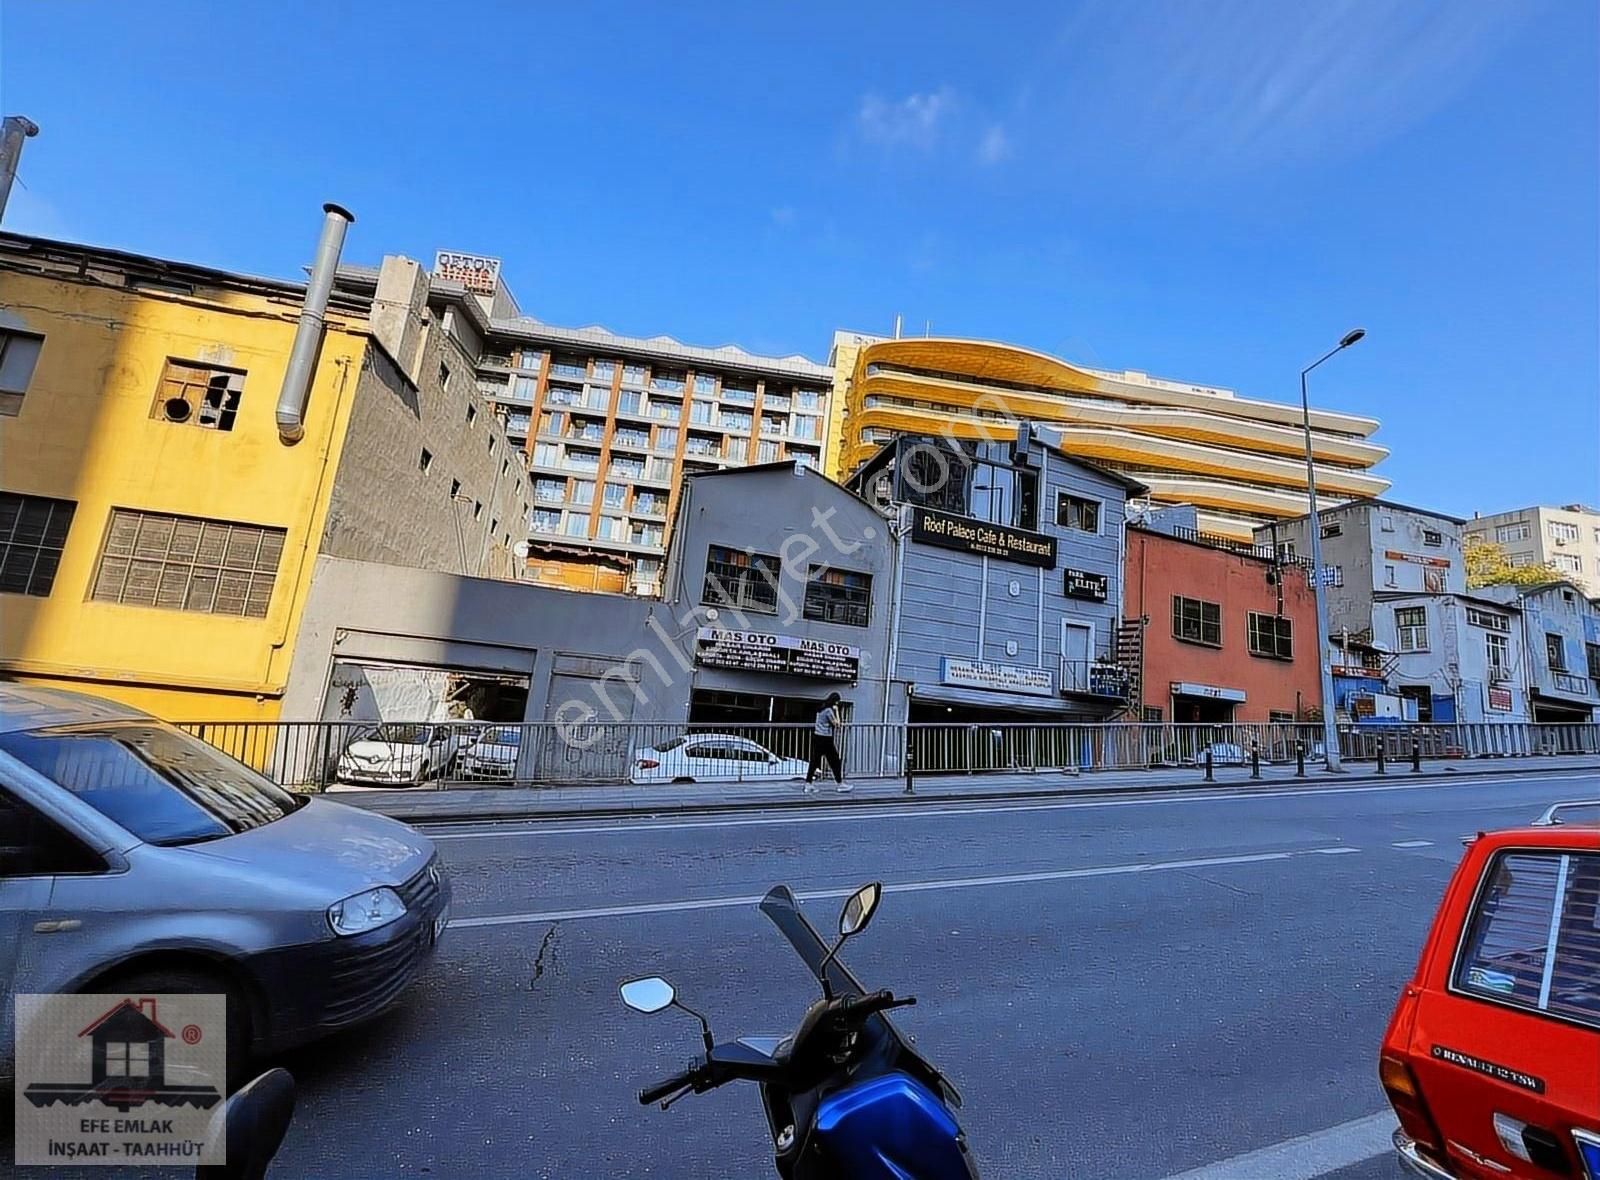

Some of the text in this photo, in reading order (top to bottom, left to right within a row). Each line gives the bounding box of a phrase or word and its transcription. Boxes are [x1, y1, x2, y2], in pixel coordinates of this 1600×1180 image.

[924, 515, 946, 534] Roof
[947, 521, 976, 541] Palace
[977, 527, 997, 546] Cafe
[999, 533, 1006, 547] &
[1007, 534, 1051, 557] Restaurant
[711, 630, 777, 646] MAS OTO
[801, 639, 851, 657] MAS OTO
[1443, 1050, 1493, 1074] RENAULT
